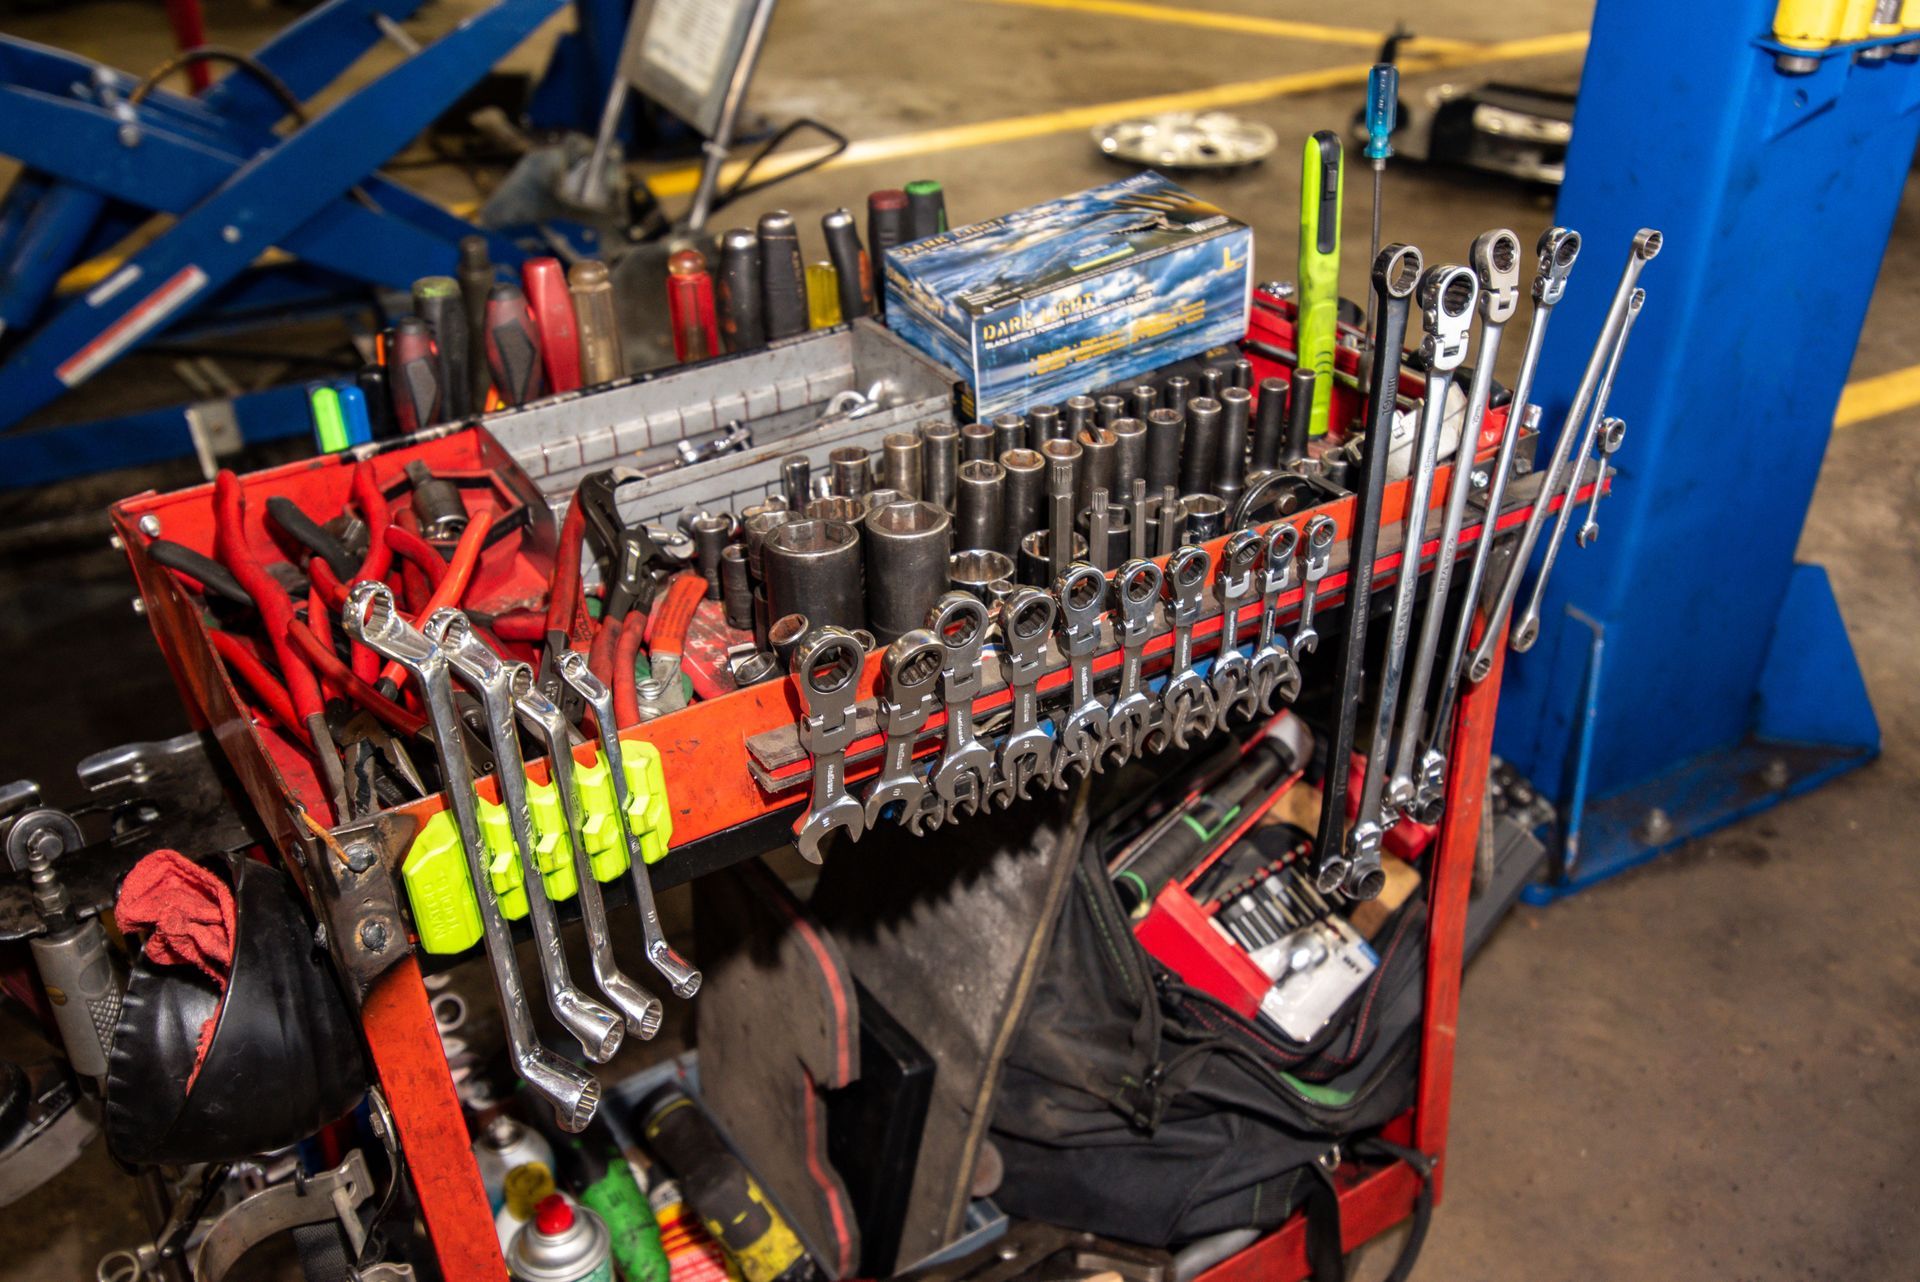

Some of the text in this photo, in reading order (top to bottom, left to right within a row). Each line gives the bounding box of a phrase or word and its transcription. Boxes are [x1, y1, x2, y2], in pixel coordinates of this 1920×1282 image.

[981, 311, 1034, 341] DARK
[1040, 291, 1095, 323] LIGHT
[1383, 376, 1397, 417] 19mm
[499, 718, 516, 739] 13
